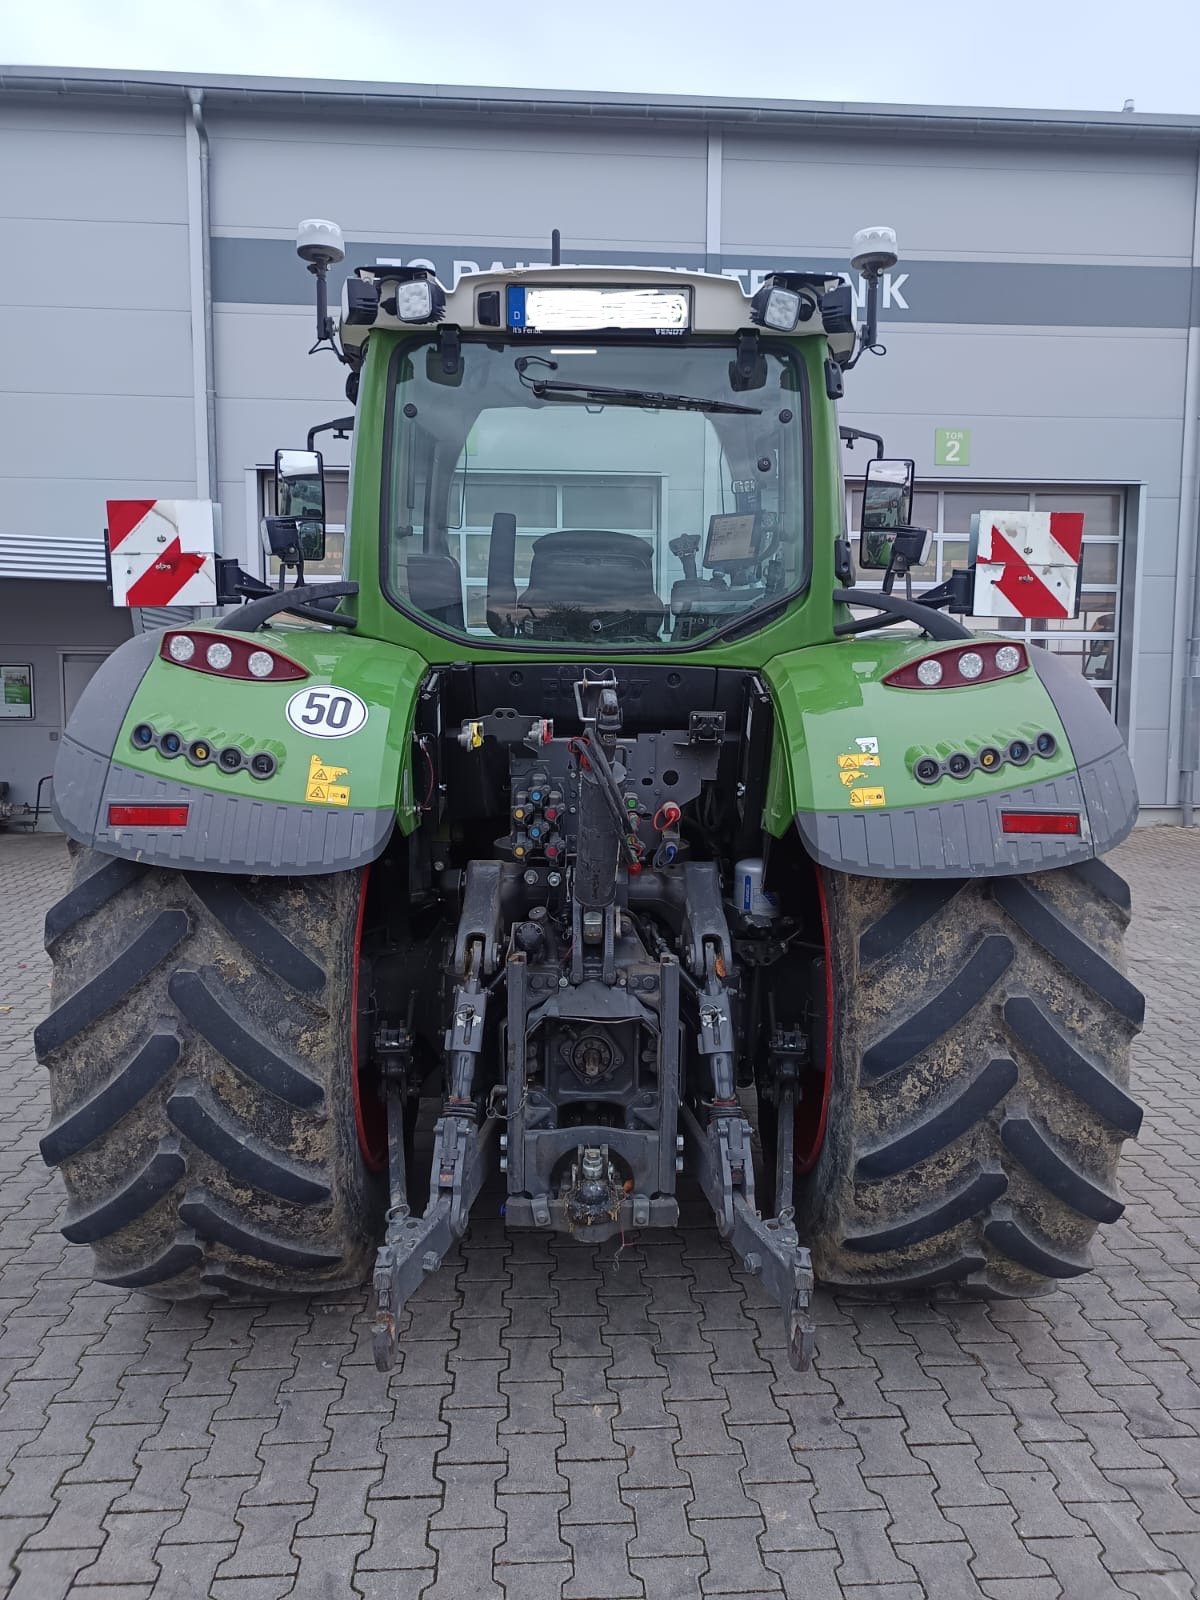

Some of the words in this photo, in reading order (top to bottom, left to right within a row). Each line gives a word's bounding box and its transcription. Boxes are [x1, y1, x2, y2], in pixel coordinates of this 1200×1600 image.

[513, 310, 521, 320] D
[945, 431, 964, 441] TOR
[945, 440, 961, 462] 2
[301, 692, 353, 729] 50
